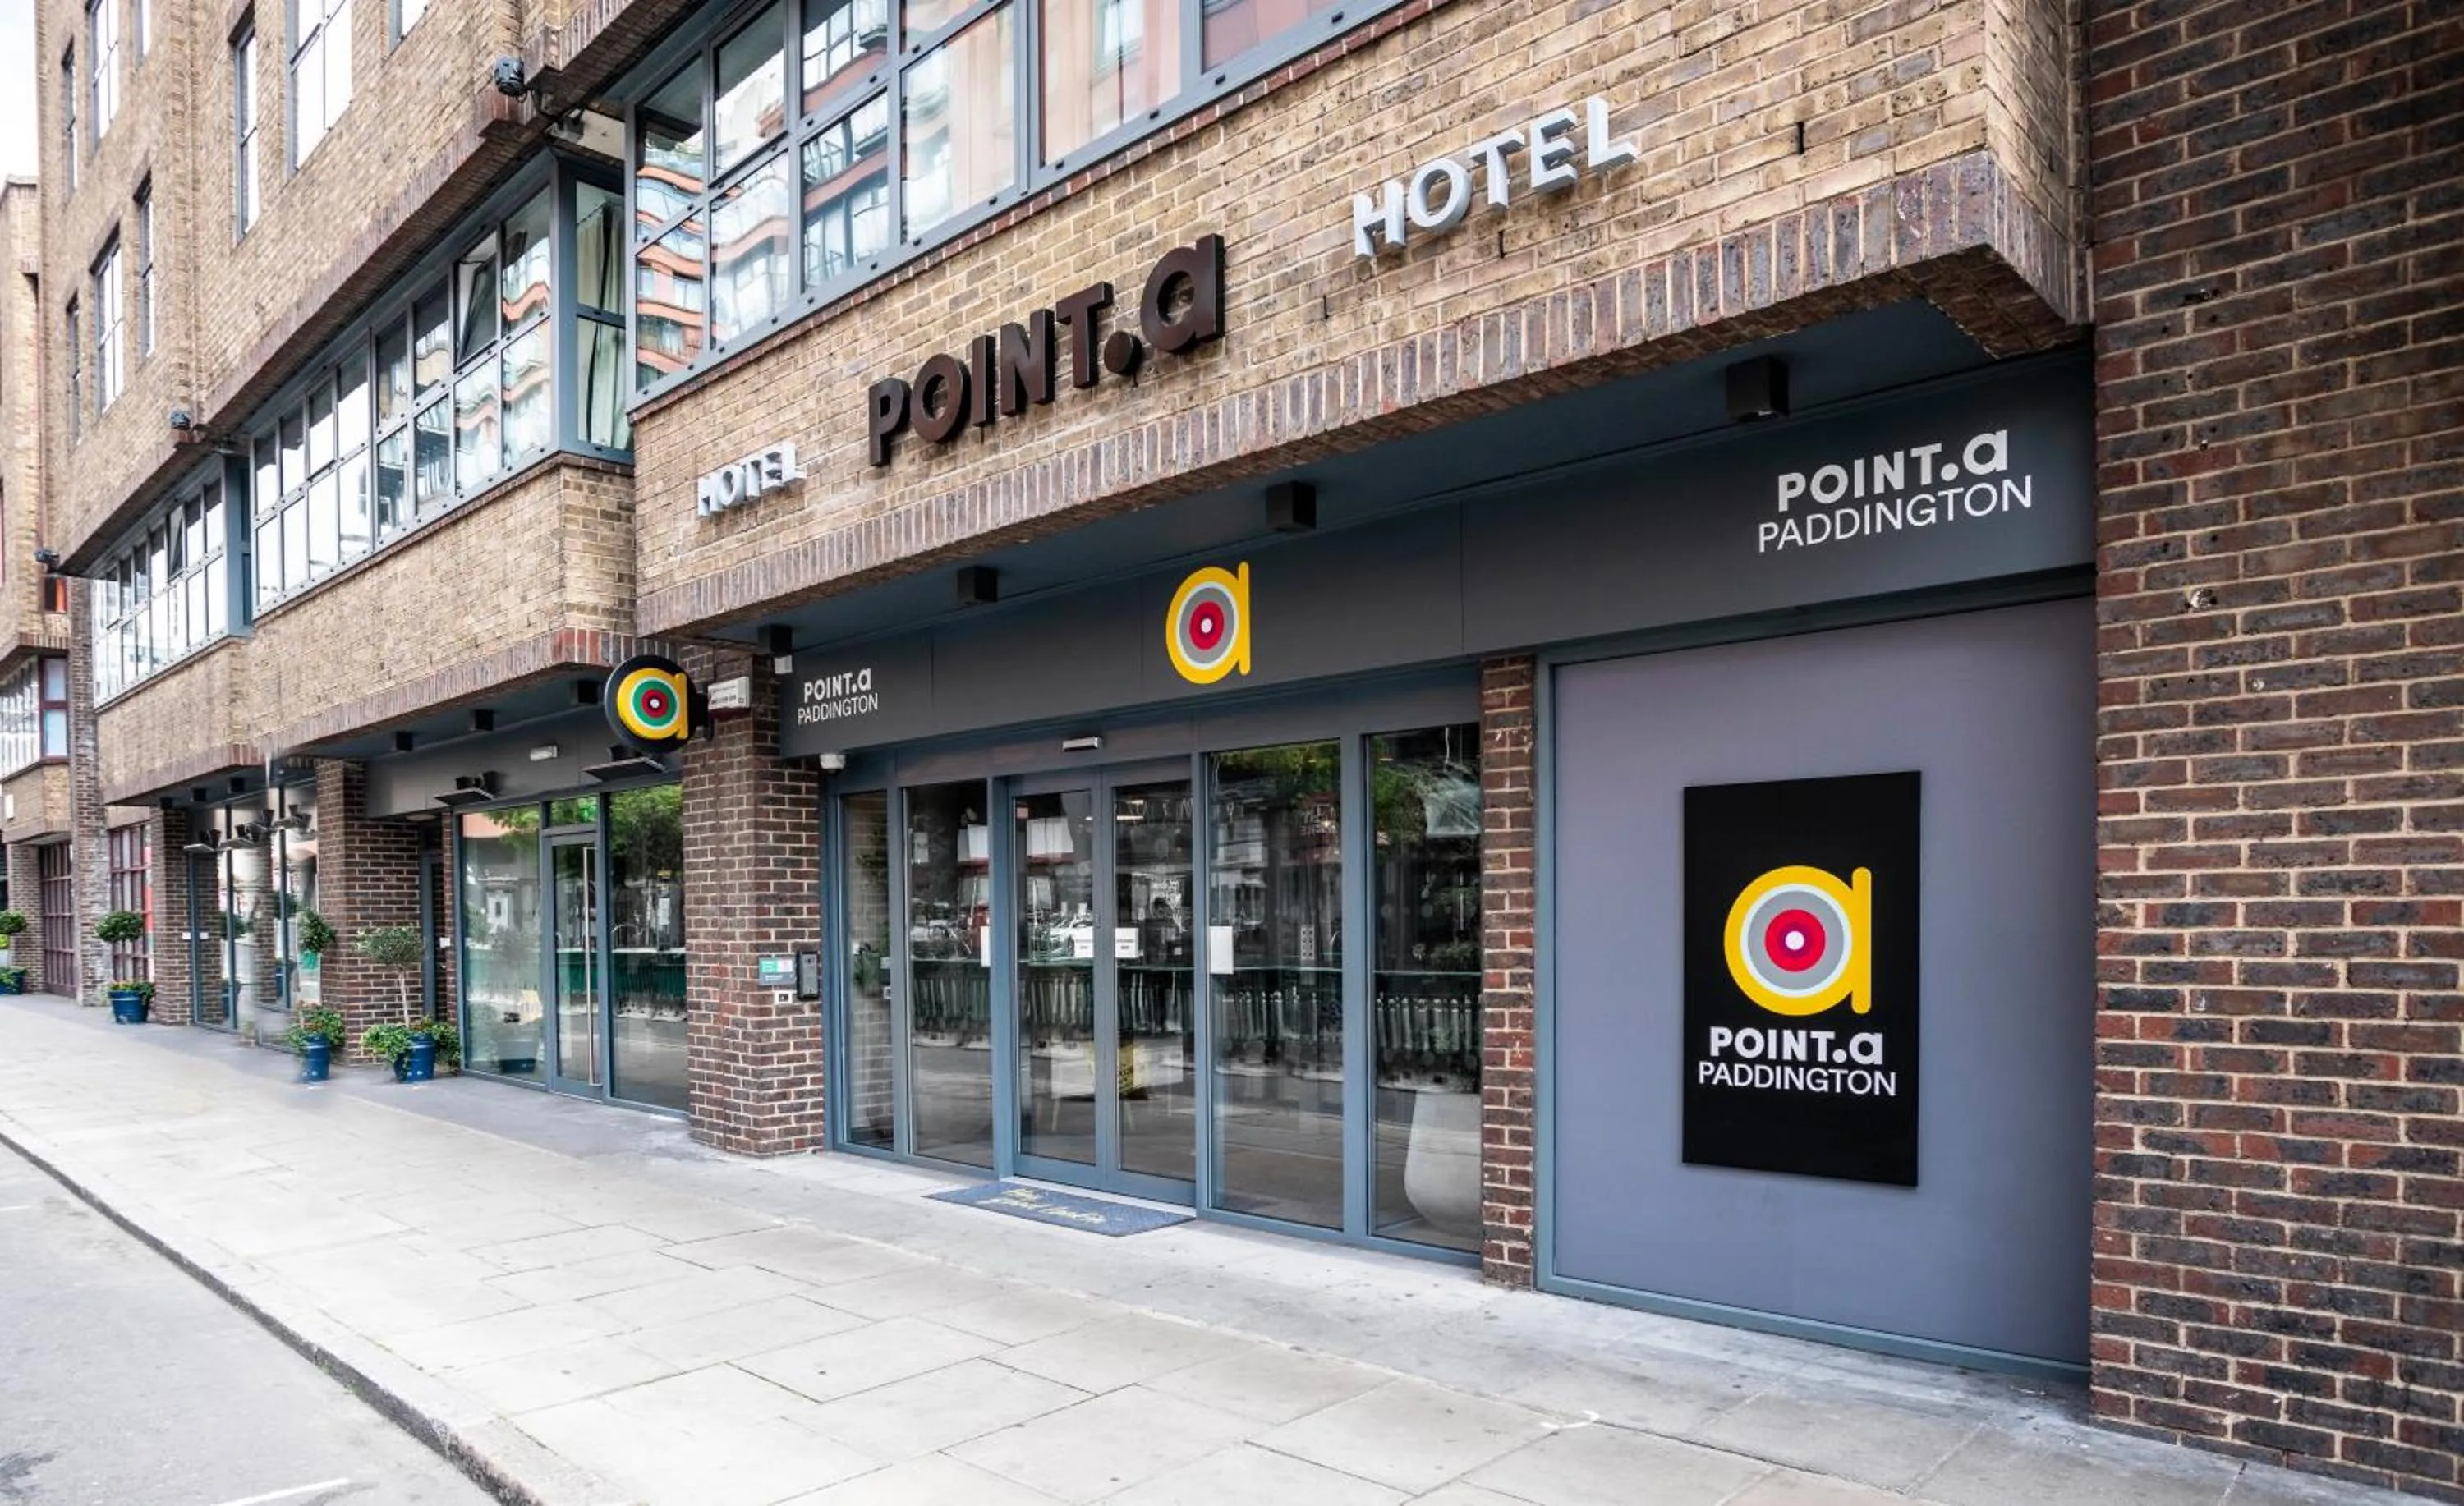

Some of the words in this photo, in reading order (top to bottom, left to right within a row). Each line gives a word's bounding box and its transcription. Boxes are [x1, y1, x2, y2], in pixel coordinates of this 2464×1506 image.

[1354, 95, 1639, 258] HOTEL
[869, 233, 1225, 466] POINT.a
[697, 441, 807, 517] HOTEL
[1777, 429, 2008, 513] POINT.a
[1758, 474, 2032, 553] PADDINGTON
[798, 692, 878, 726] PADDINGTON
[804, 668, 871, 704] POINT.a
[1698, 1060, 1897, 1097] PADDINGTON
[1709, 1026, 1884, 1065] POINT.a
